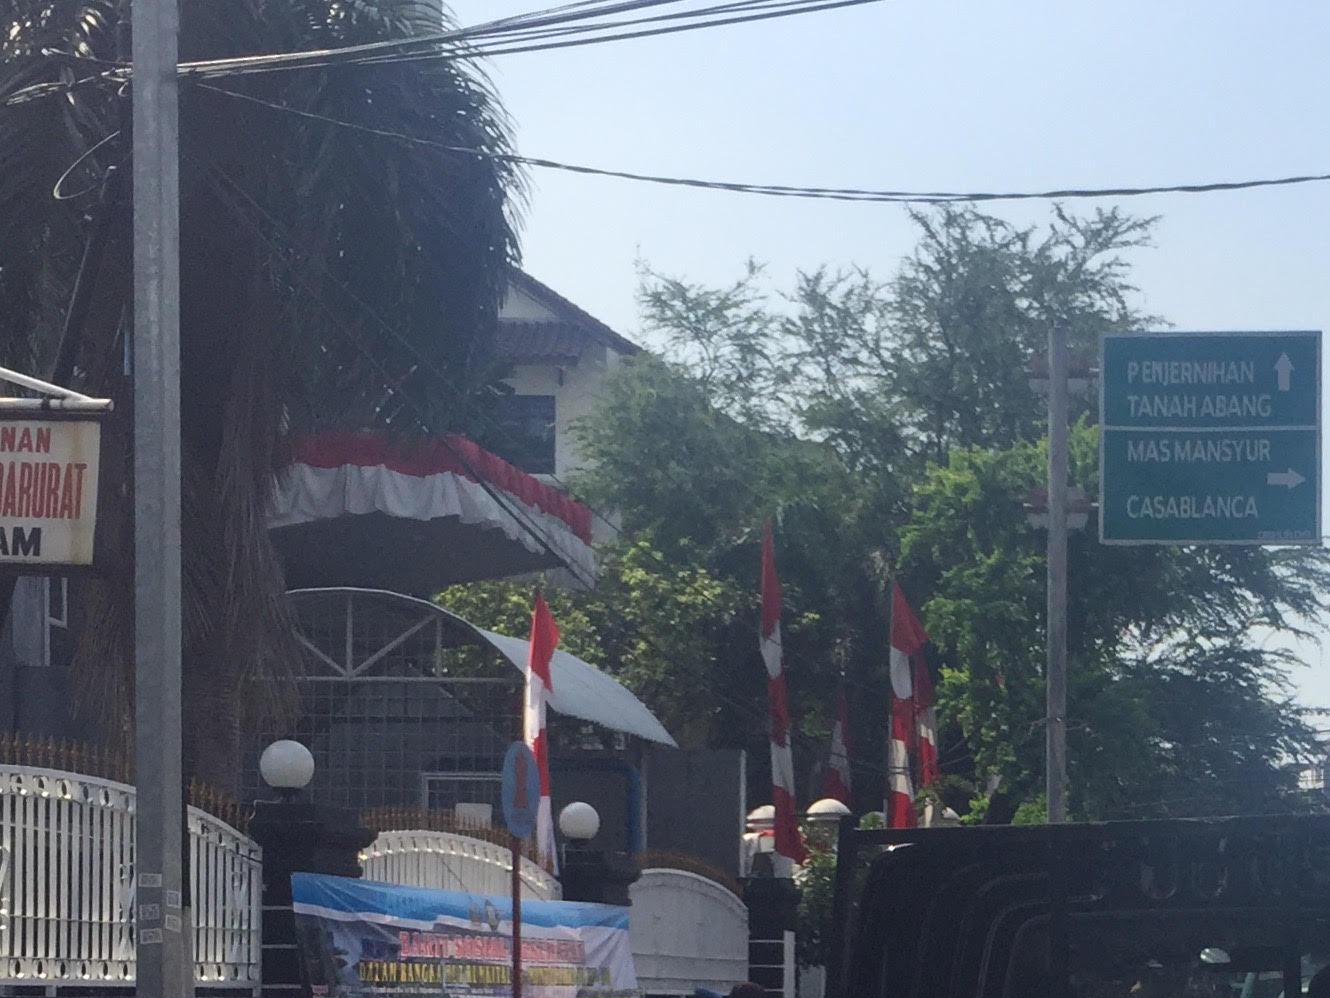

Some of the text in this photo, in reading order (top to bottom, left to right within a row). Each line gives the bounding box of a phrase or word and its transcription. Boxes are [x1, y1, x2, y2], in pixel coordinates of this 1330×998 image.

[1127, 394, 1272, 418] TANAH ABANG
[1127, 439, 1271, 462] MAS MANSYUR
[1126, 496, 1258, 518] CASABLANCA
